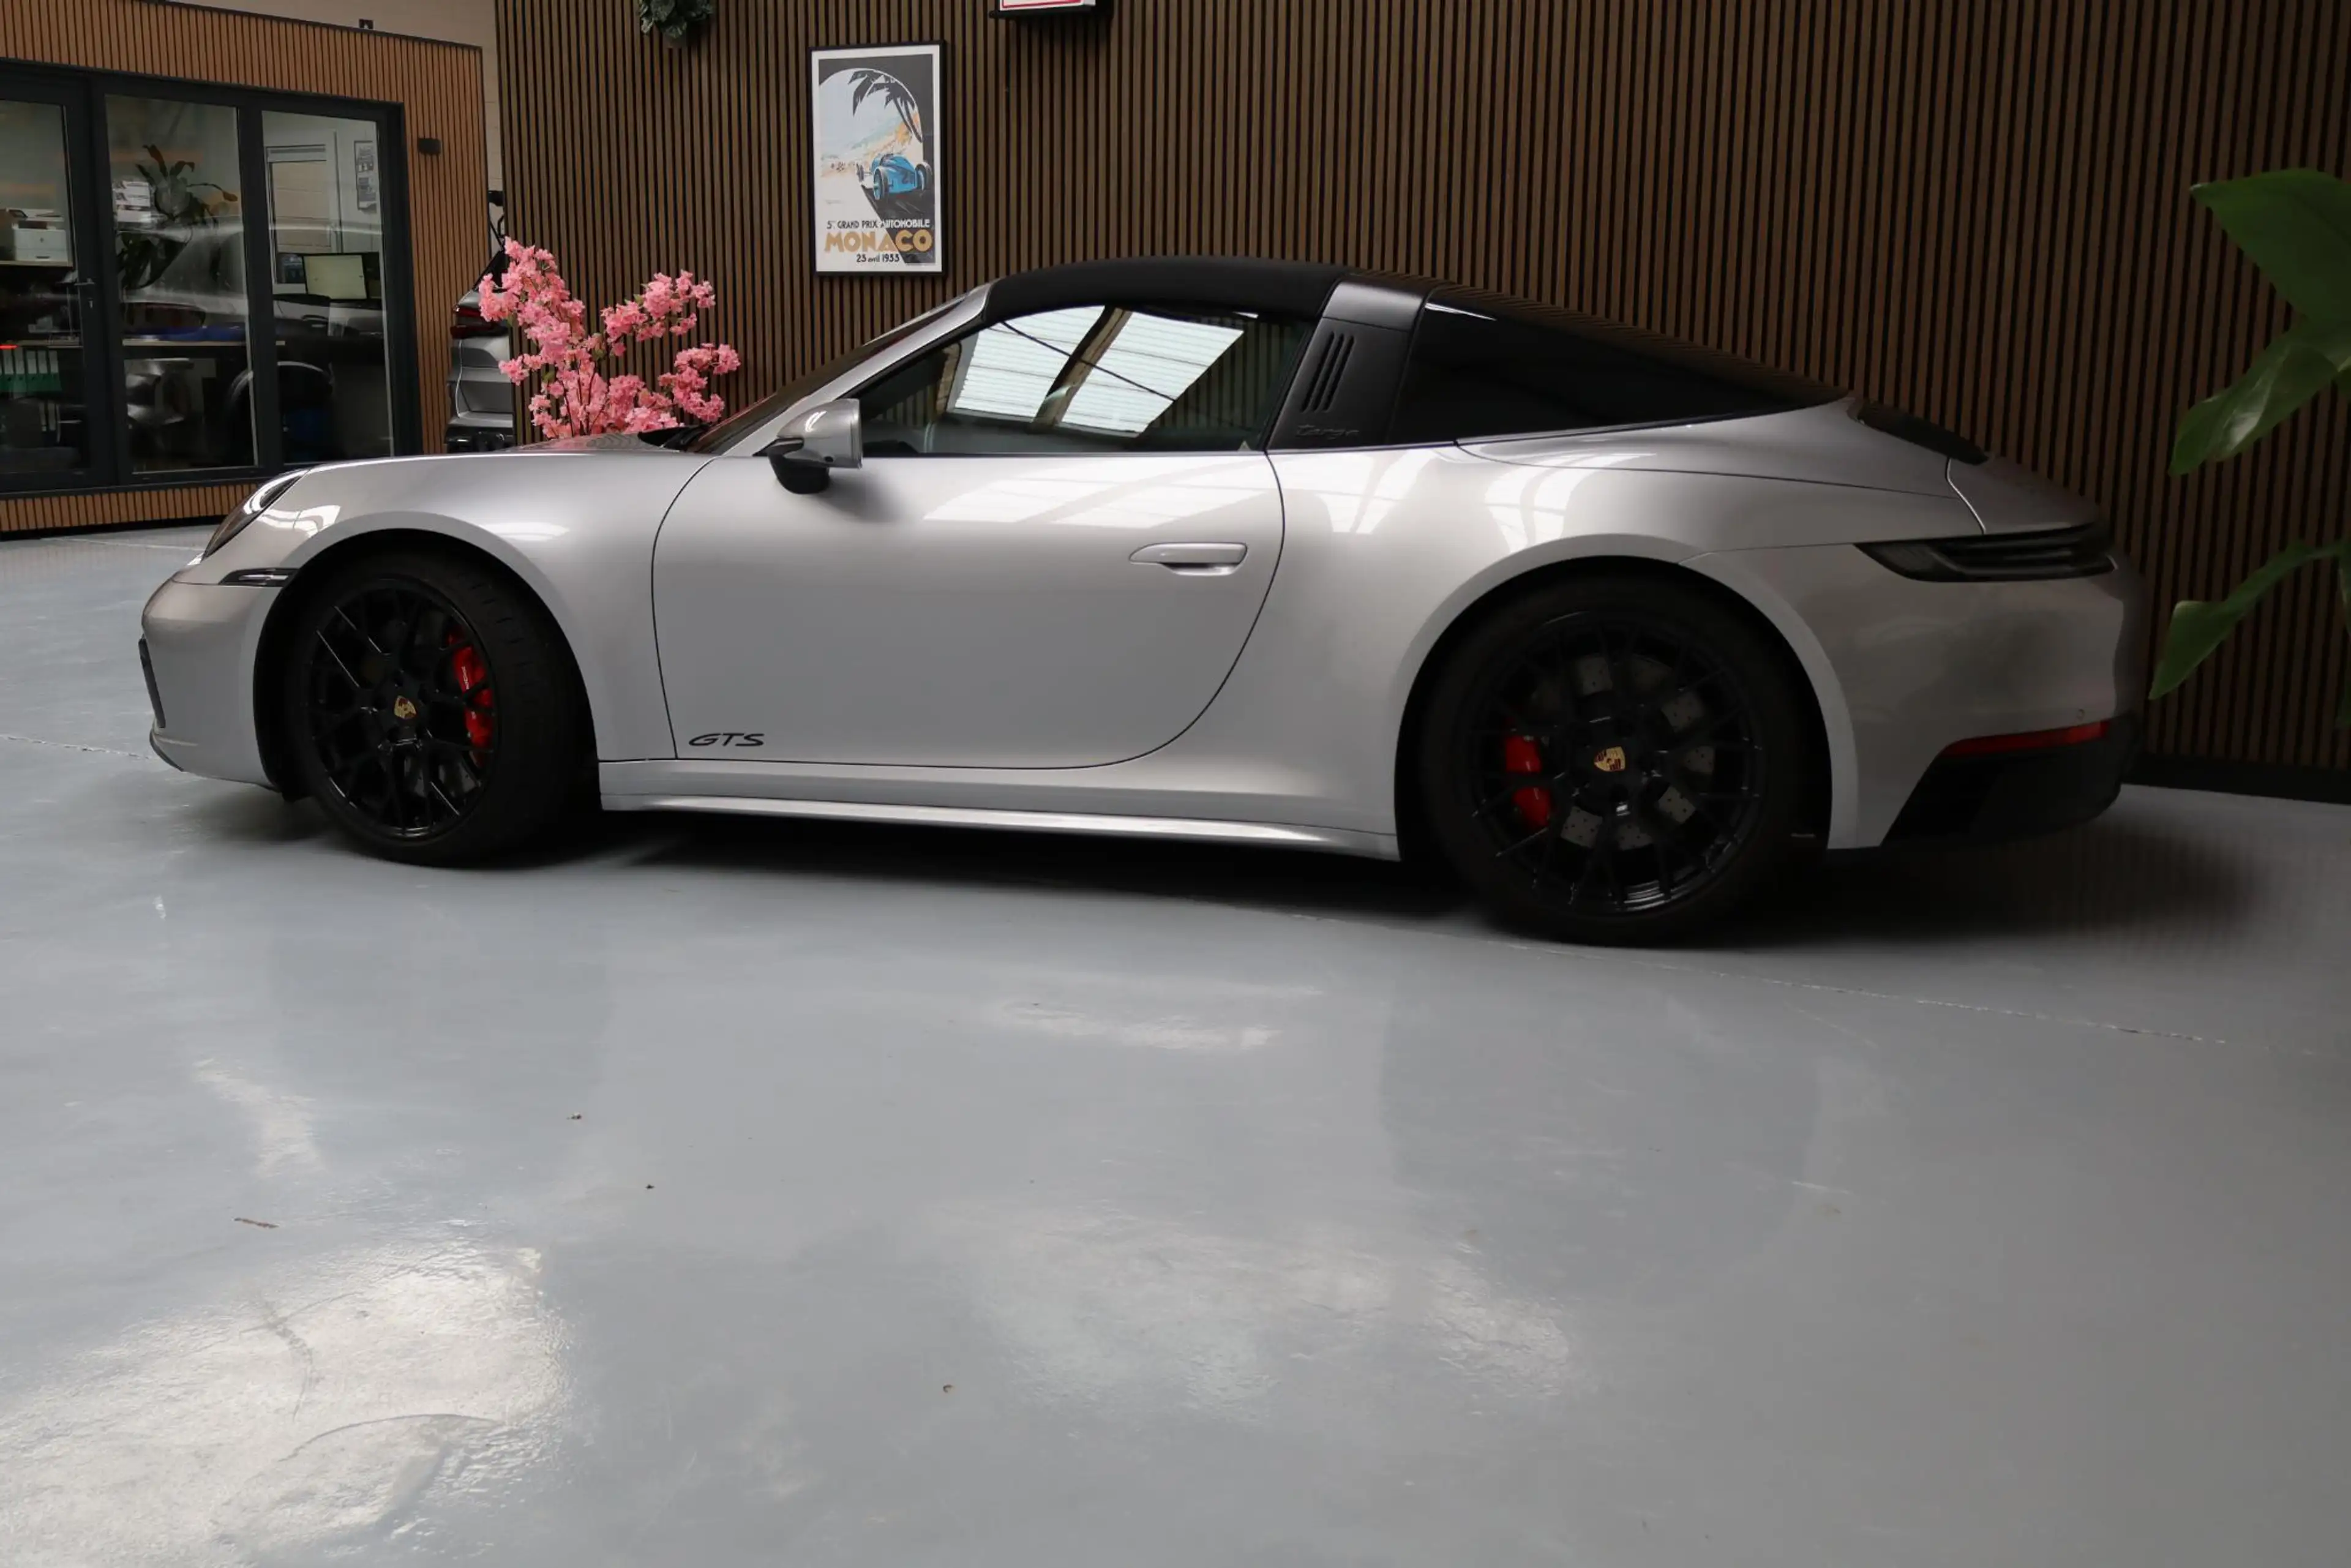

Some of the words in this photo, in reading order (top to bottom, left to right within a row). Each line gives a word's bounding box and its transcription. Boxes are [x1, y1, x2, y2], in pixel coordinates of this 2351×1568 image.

[837, 220, 860, 229] GRAND
[862, 220, 878, 228] PRIX
[880, 219, 930, 228] AUTOMOBILE
[825, 229, 932, 253] MONACO
[689, 733, 765, 747] GTS
